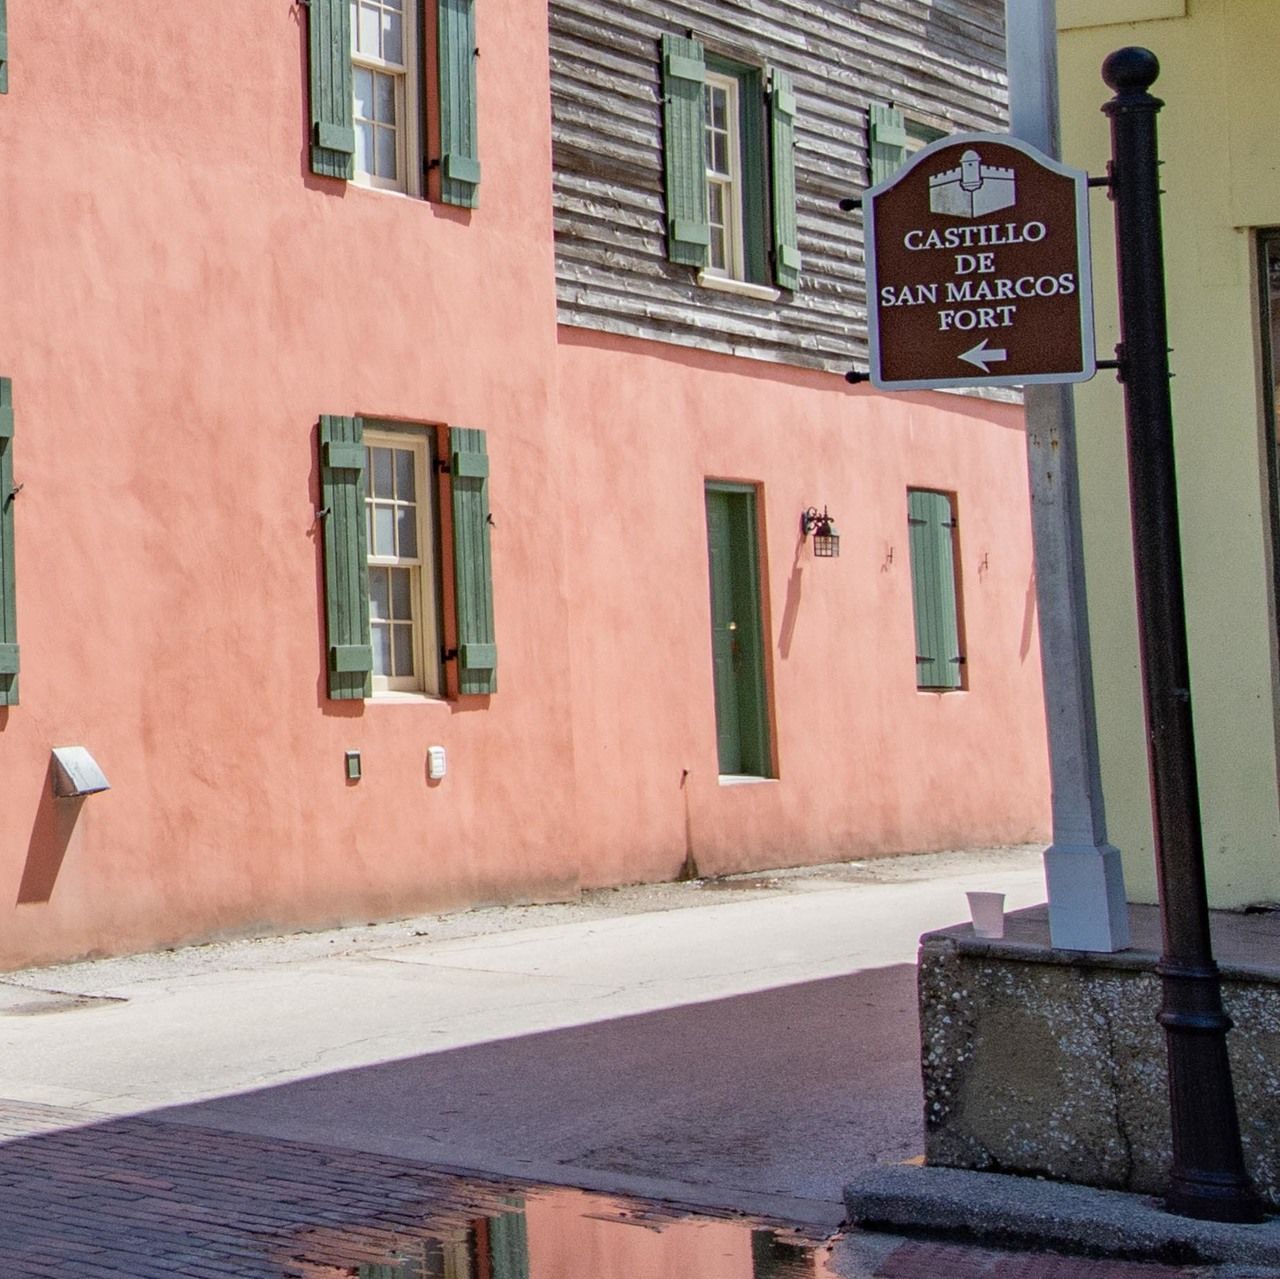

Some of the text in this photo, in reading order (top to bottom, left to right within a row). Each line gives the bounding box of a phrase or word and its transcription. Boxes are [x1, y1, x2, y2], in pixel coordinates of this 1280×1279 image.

[904, 221, 1046, 251] CASTILLO
[954, 252, 996, 275] DE
[881, 273, 1075, 307] SAN MARCOS
[938, 306, 1017, 331] FORT
